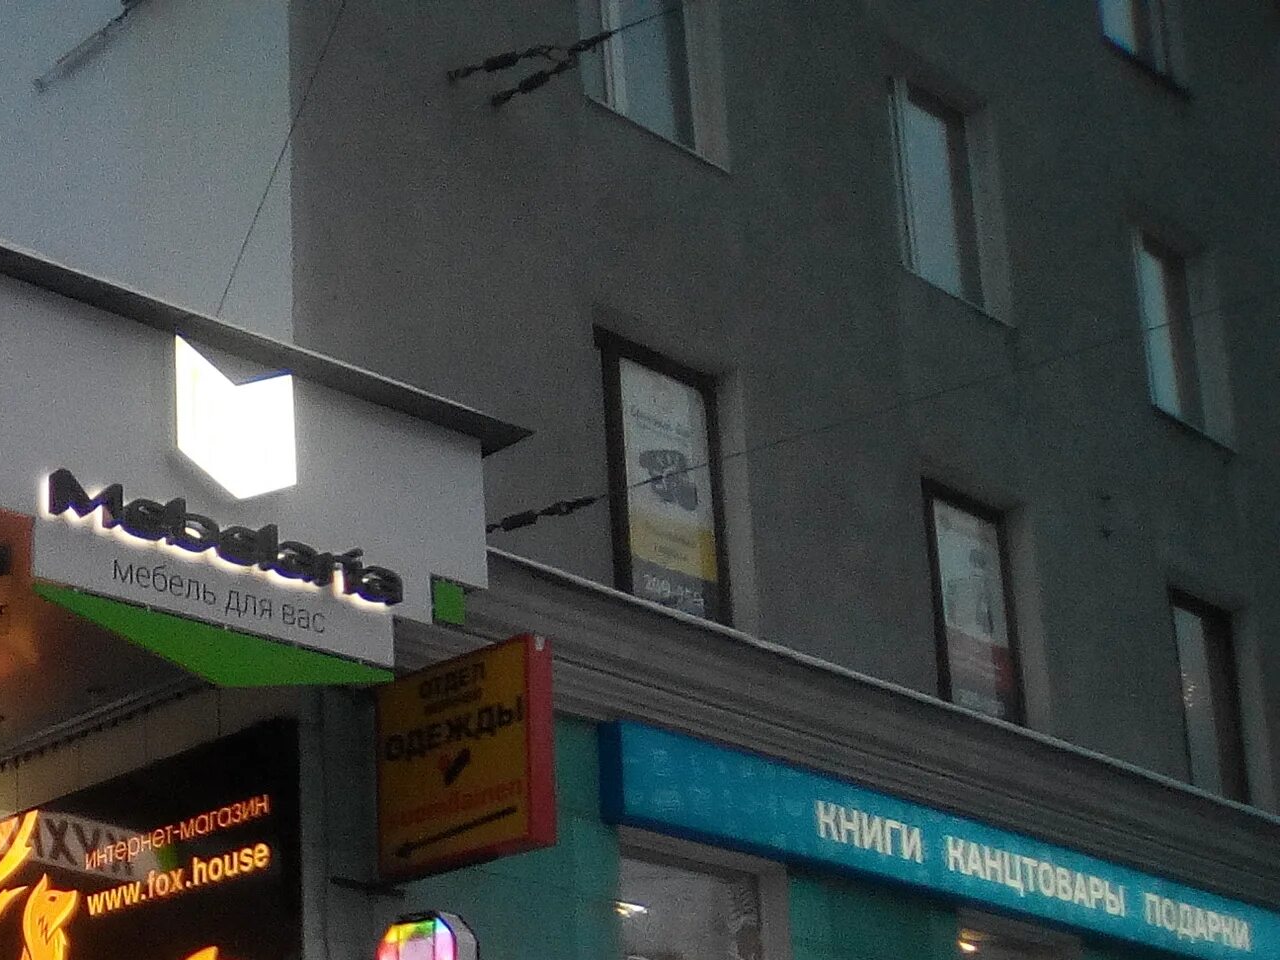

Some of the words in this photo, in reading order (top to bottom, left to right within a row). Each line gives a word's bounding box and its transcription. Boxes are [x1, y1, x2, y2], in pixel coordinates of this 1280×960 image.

[112, 558, 216, 605] мебель
[224, 589, 273, 619] для
[282, 602, 326, 634] вас
[385, 693, 524, 762] ОДЕЖДЫ
[84, 793, 271, 871] интернет-магазин
[815, 800, 923, 864] КНИГИ
[945, 836, 1126, 917] КАНЦТОВАРЫ
[87, 841, 272, 917] www.fox.house
